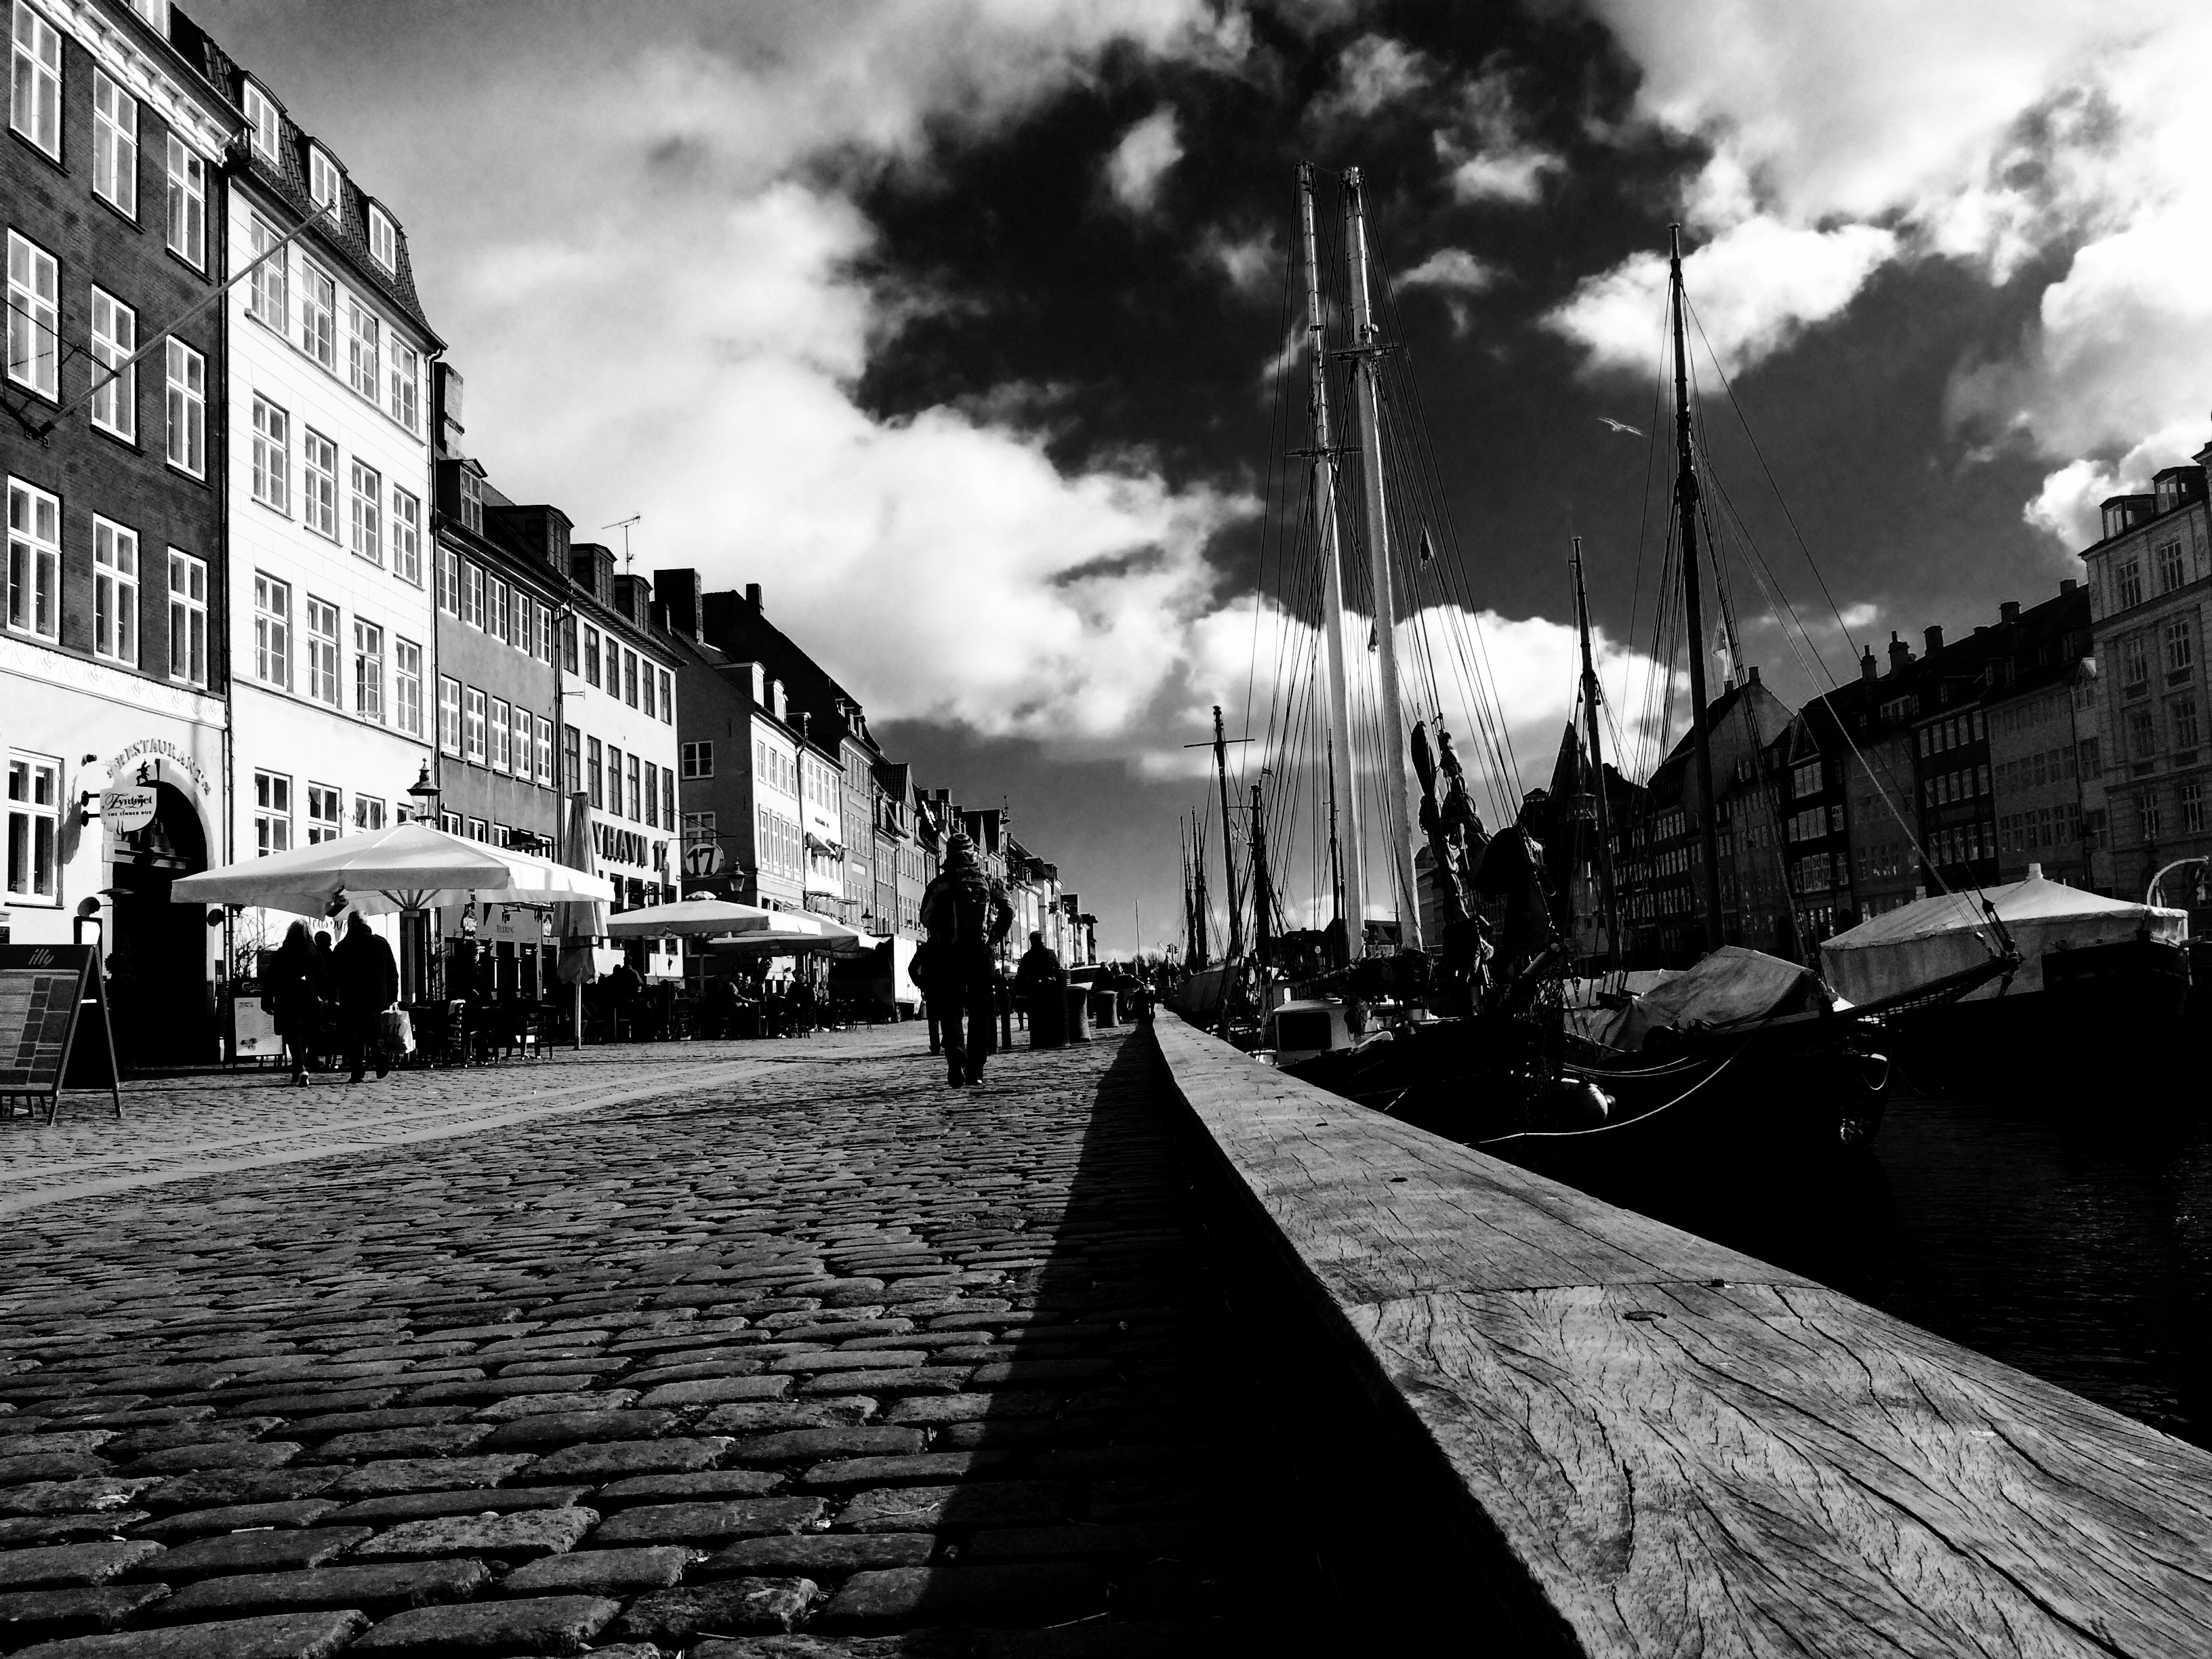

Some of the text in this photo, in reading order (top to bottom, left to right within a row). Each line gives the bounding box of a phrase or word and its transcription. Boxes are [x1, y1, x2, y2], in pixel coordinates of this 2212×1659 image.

[113, 739, 205, 783] RESTAURANT
[592, 821, 649, 868] YHAVN
[687, 847, 716, 876] 17
[28, 949, 54, 968] illy
